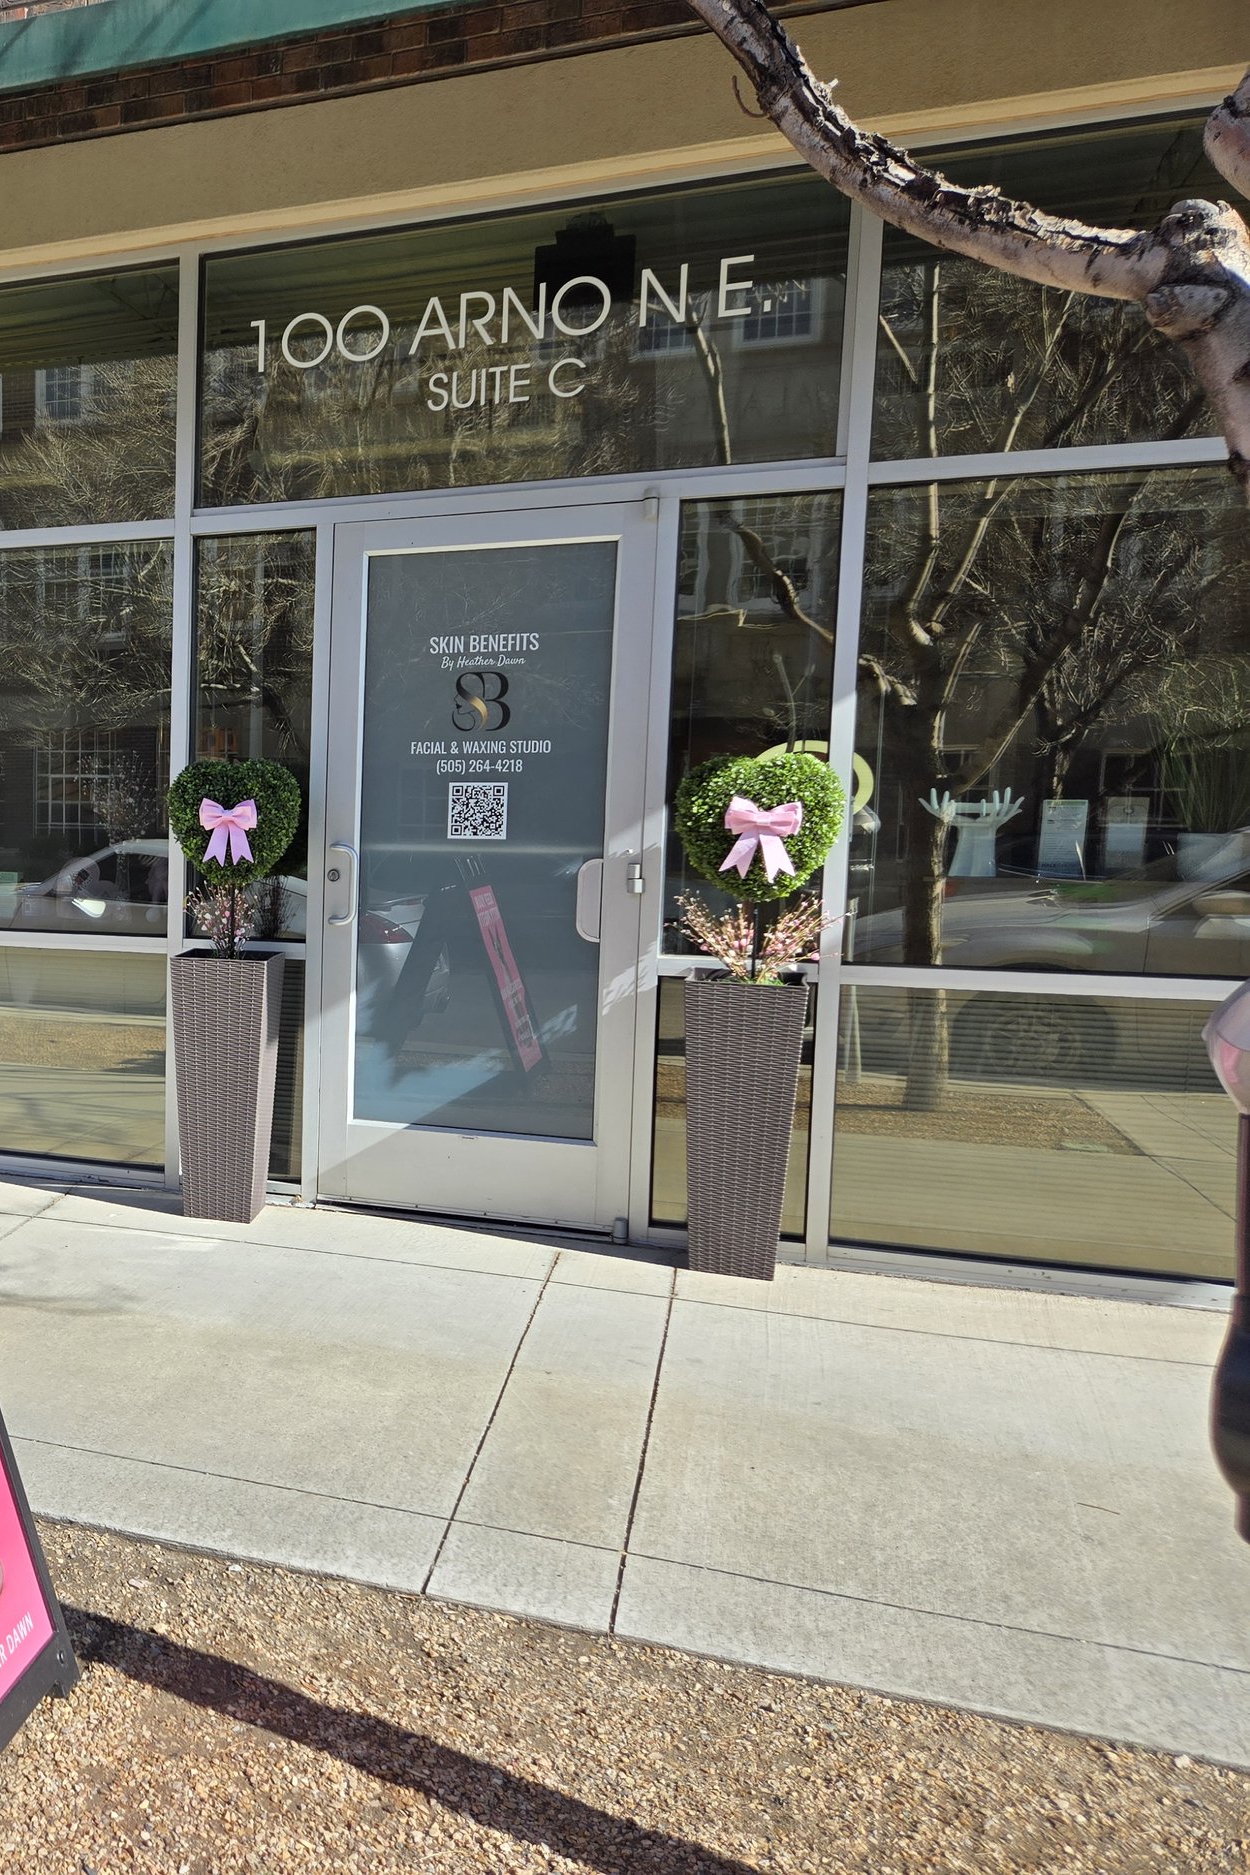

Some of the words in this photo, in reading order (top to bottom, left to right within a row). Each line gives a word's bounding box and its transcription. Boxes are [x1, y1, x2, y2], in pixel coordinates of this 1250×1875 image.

[251, 305, 390, 372] 100
[409, 276, 611, 355] ARNO
[426, 364, 531, 411] SUITE
[548, 358, 587, 398] C
[430, 636, 464, 654] SKIN
[469, 633, 540, 653] BENEFITS
[441, 656, 454, 671] By
[457, 656, 496, 668] Heather
[497, 655, 526, 667] Dawn
[411, 741, 447, 754] FACIAL
[450, 741, 459, 754] &
[463, 740, 507, 754] WAXING
[510, 740, 551, 753] STUDIO
[436, 760, 466, 775] (505)
[469, 759, 523, 773] 264-4218
[6, 1612, 34, 1659] DAWN
